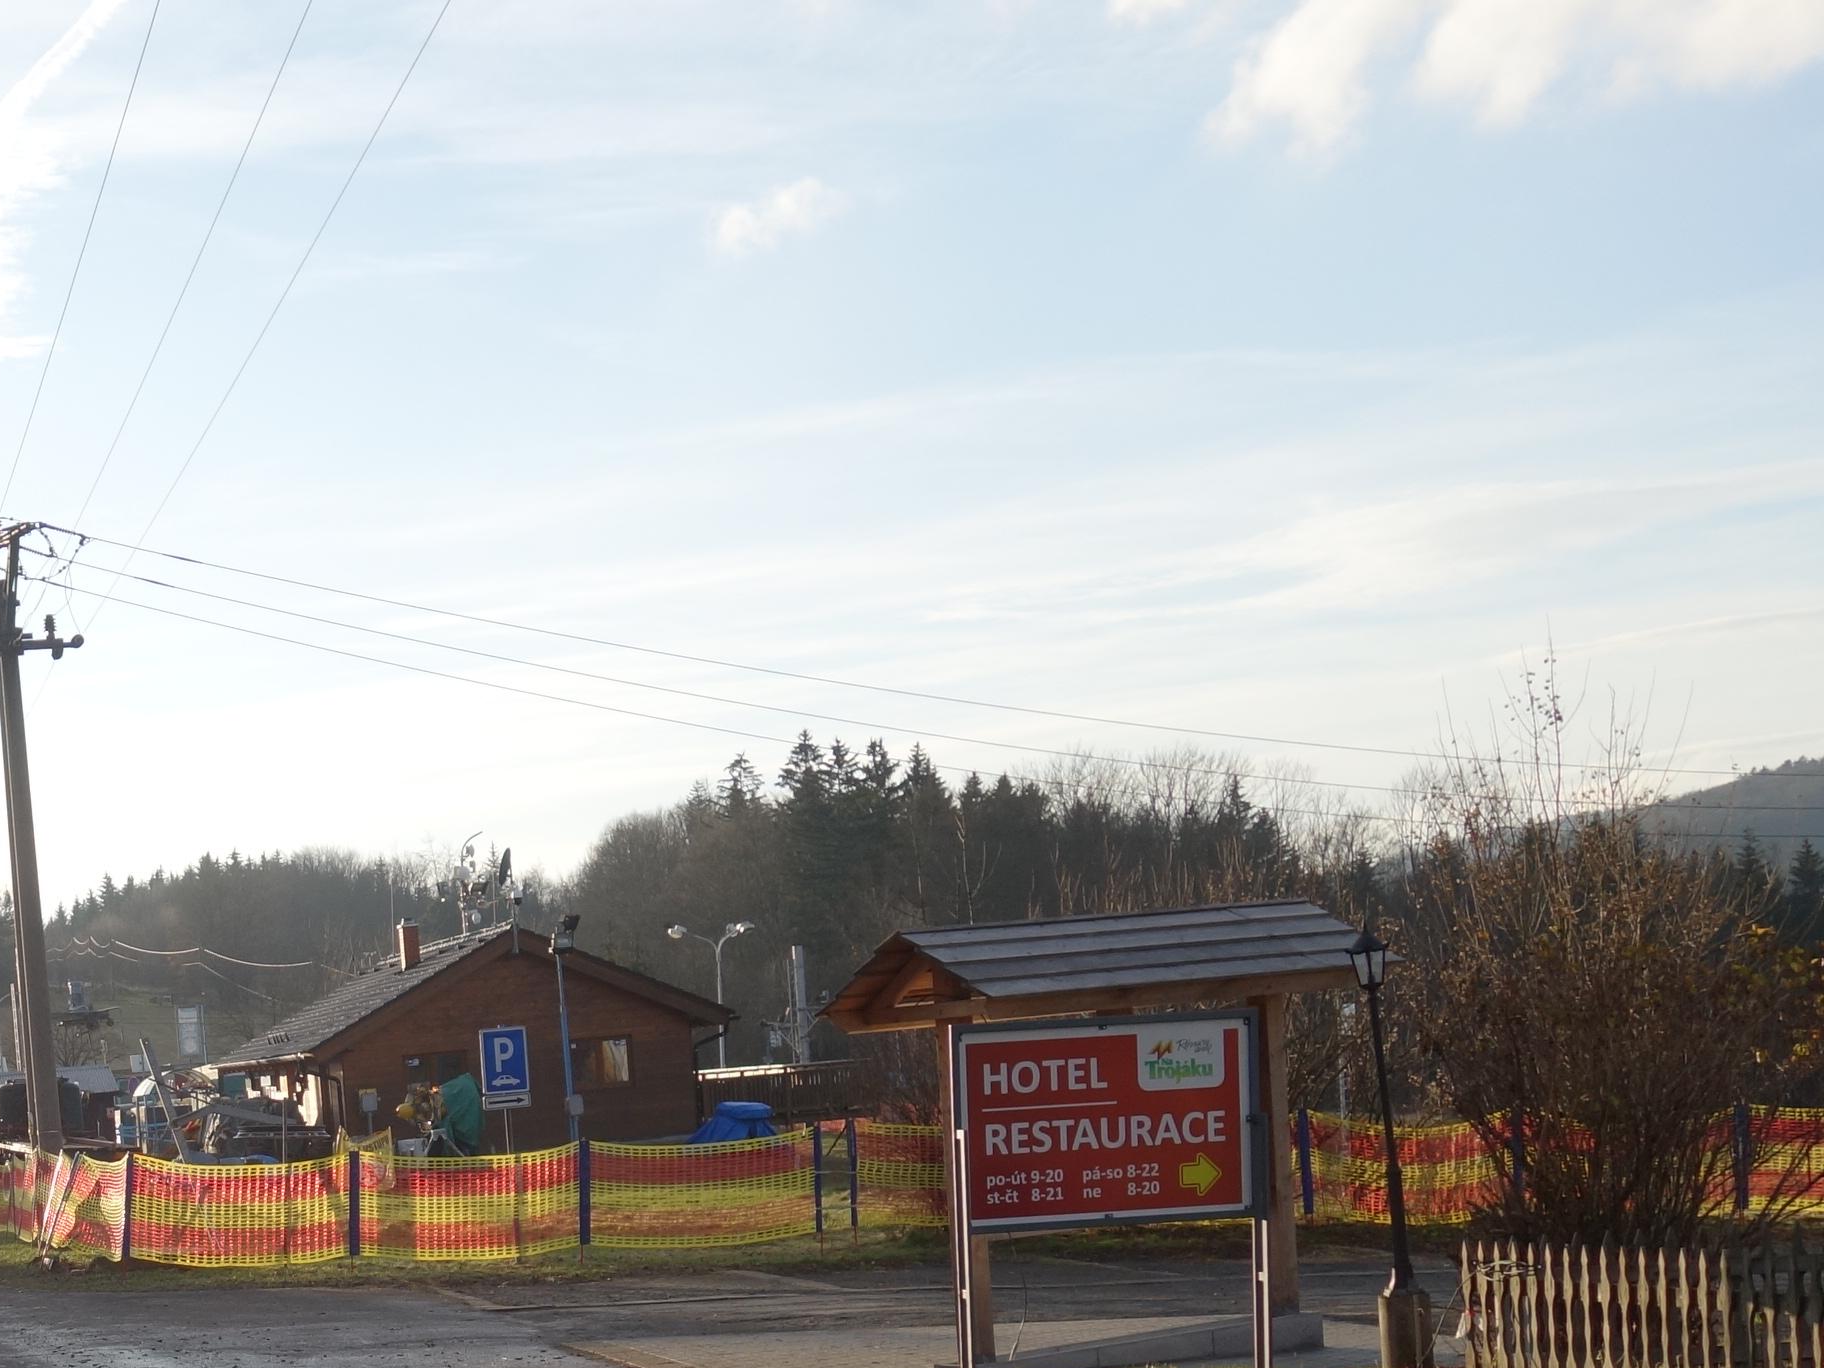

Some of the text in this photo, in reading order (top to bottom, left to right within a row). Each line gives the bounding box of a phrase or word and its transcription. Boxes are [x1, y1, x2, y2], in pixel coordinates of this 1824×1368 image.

[494, 1037, 514, 1072] P
[982, 1057, 1108, 1096] HOTEL
[1144, 1058, 1214, 1085] Trojáku
[984, 1110, 1226, 1156] RESTAURACE
[986, 1163, 1160, 1189] po-út 9-20 pá-so 8-22
[986, 1180, 1160, 1205] st-čt 8-21 ne 8-20
